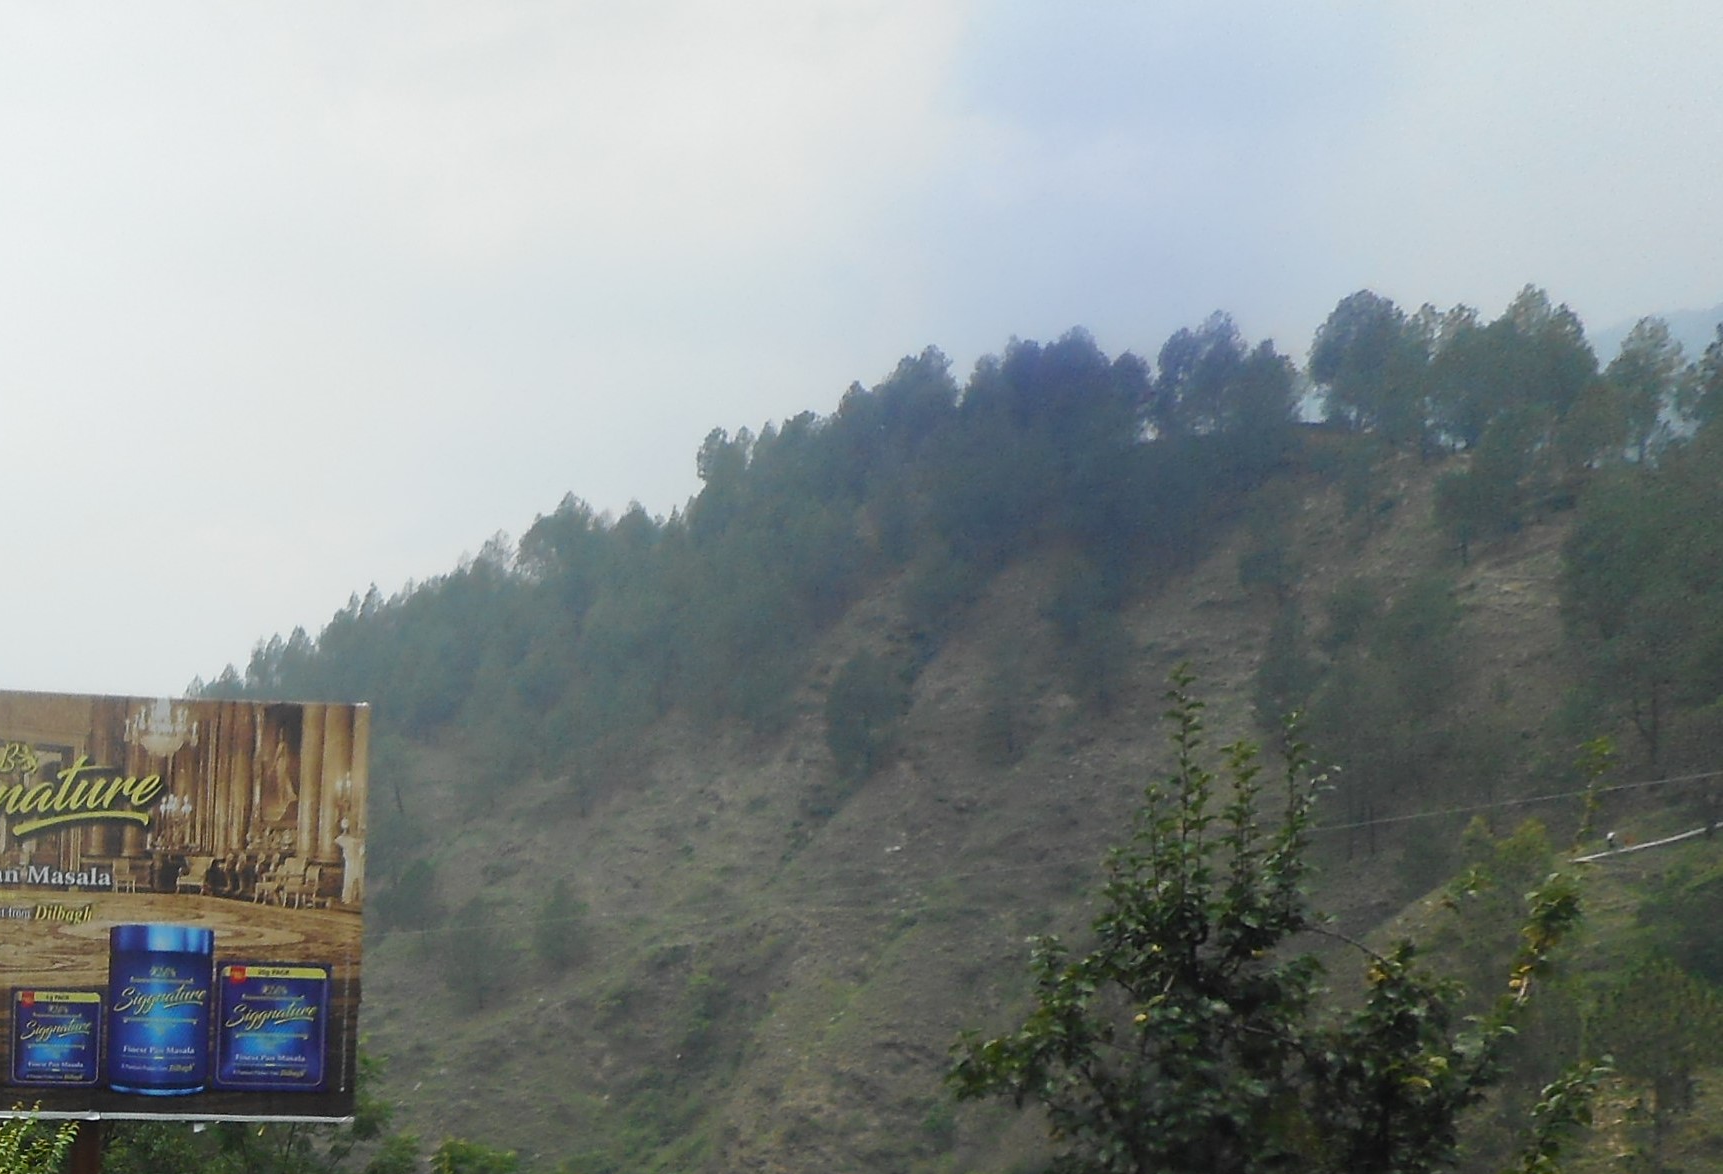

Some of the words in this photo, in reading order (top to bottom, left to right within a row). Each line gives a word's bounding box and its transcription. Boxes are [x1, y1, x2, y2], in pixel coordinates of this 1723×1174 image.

[26, 865, 112, 887] Masala
[8, 907, 31, 920] from
[34, 904, 93, 924] Dilbagh
[113, 984, 207, 1015] Siggnature
[224, 1001, 318, 1031] Siggnature
